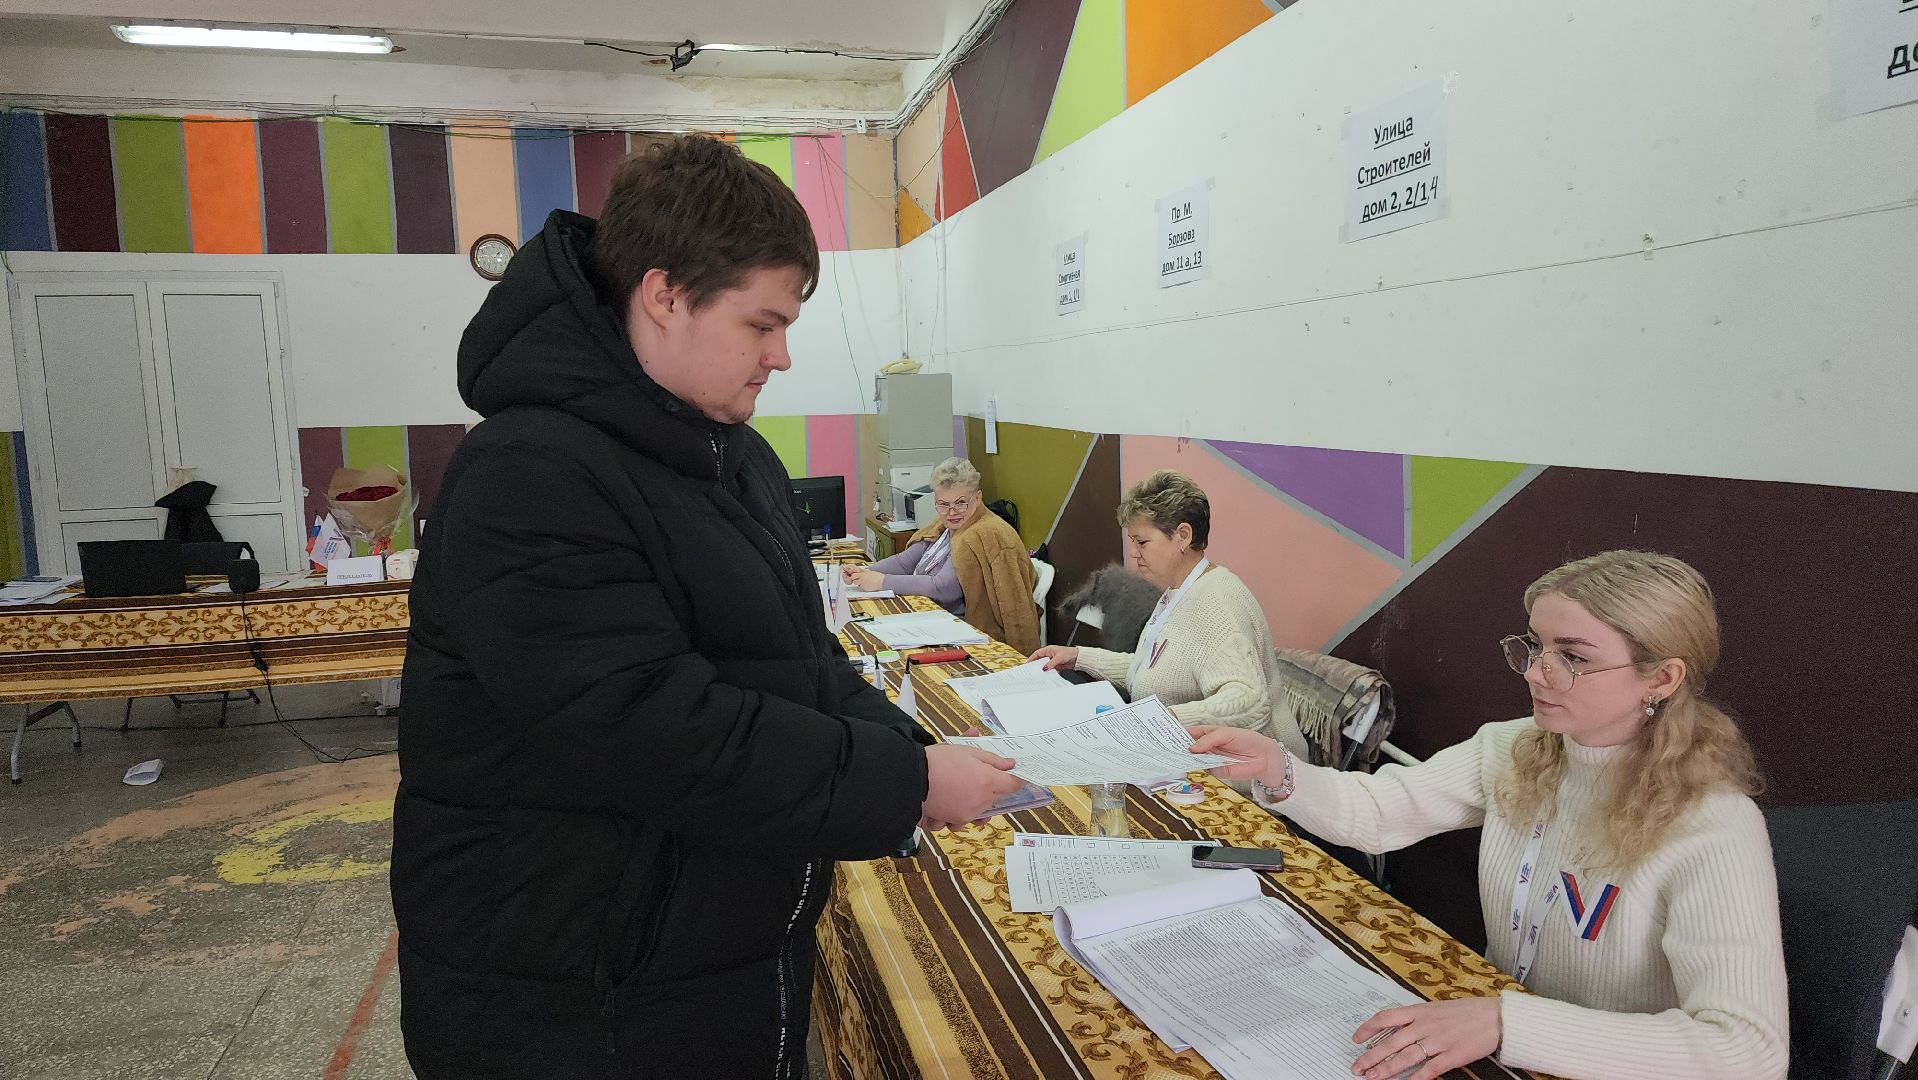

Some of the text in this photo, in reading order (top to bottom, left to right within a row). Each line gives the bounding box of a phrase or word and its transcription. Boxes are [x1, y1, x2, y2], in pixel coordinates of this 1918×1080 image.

[1374, 117, 1413, 145] Улица
[1357, 141, 1431, 185] Строителей
[1171, 207, 1181, 222] Пр
[1362, 198, 1387, 222] дом
[1162, 260, 1174, 275] дом
[1193, 251, 1202, 266] 13
